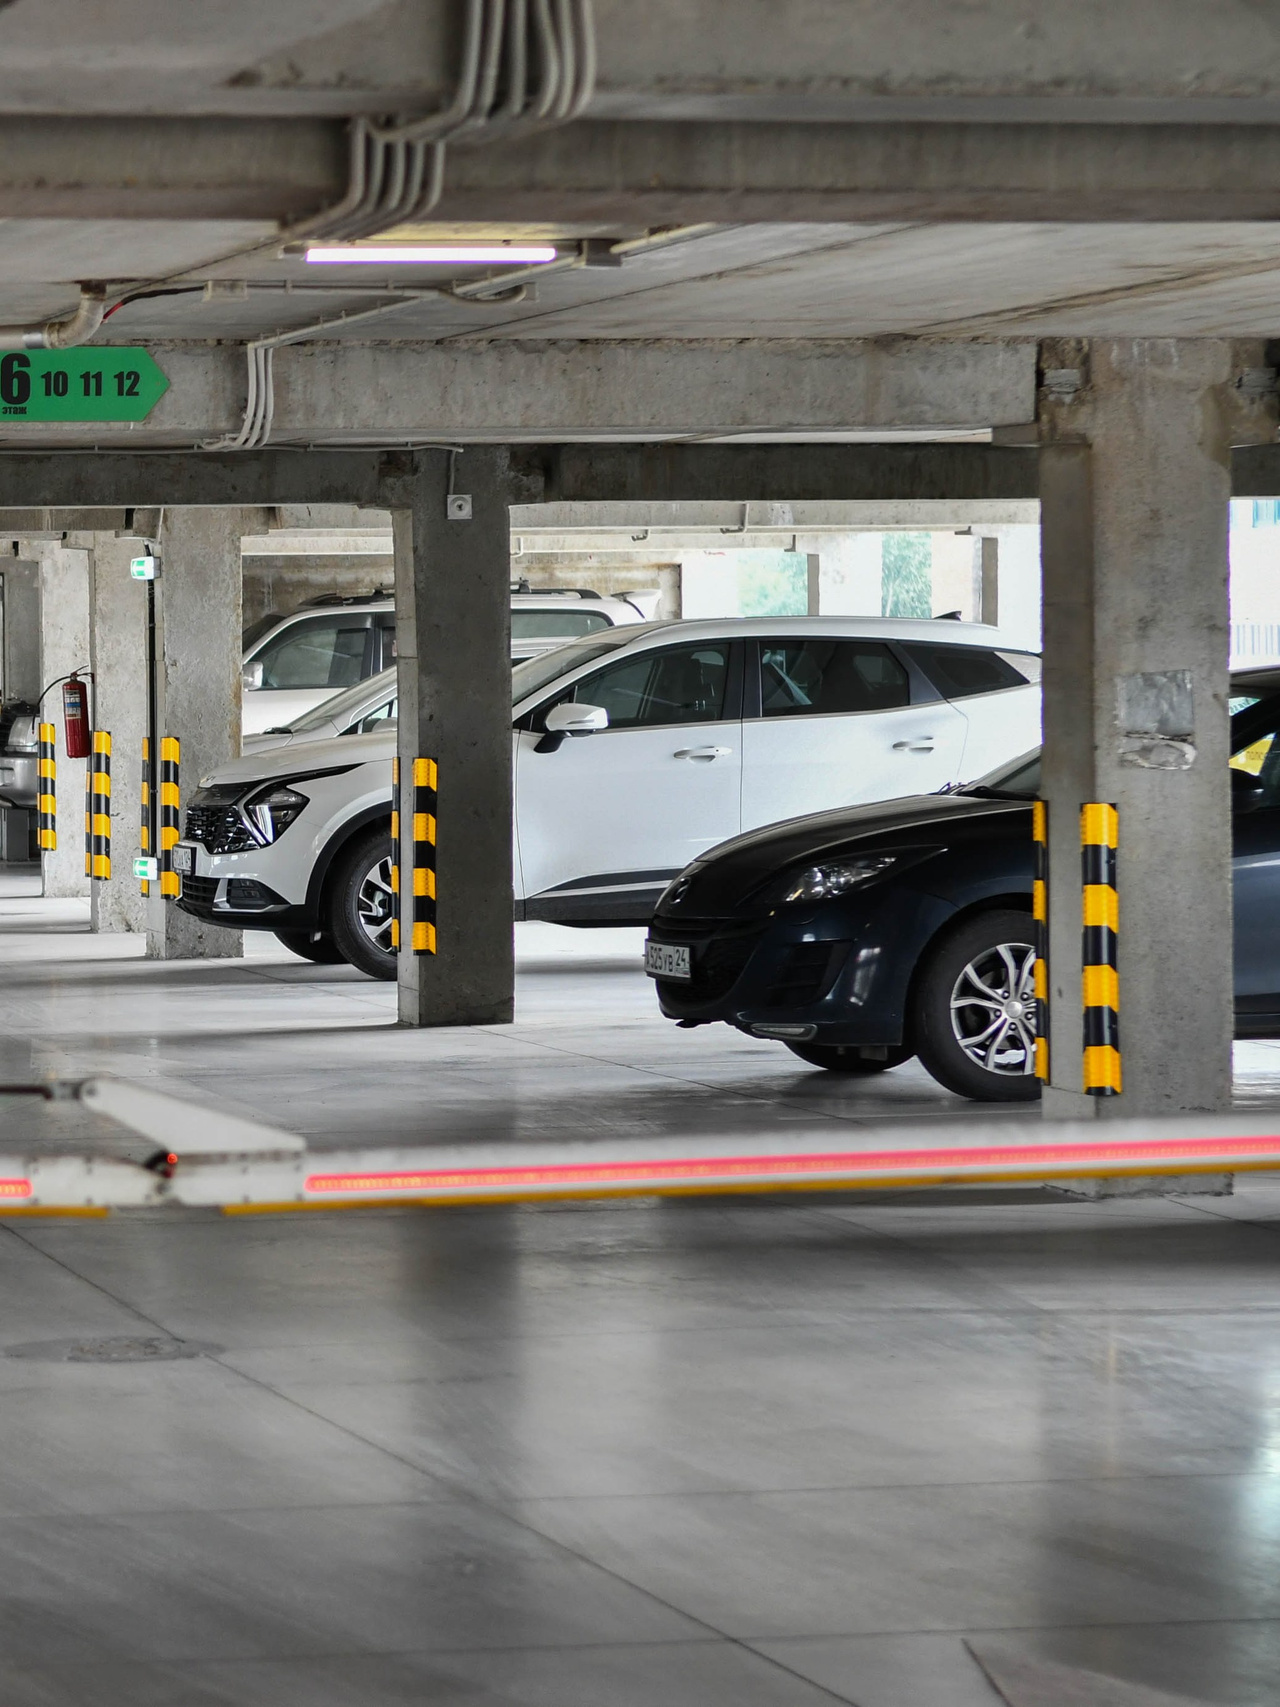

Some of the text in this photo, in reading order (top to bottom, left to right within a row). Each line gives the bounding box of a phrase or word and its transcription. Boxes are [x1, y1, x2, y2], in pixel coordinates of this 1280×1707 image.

[0, 352, 31, 405] 6
[41, 370, 69, 397] 10
[80, 370, 102, 397] 11
[114, 370, 140, 397] 12
[2, 406, 27, 415] этаж
[675, 948, 687, 968] 24
